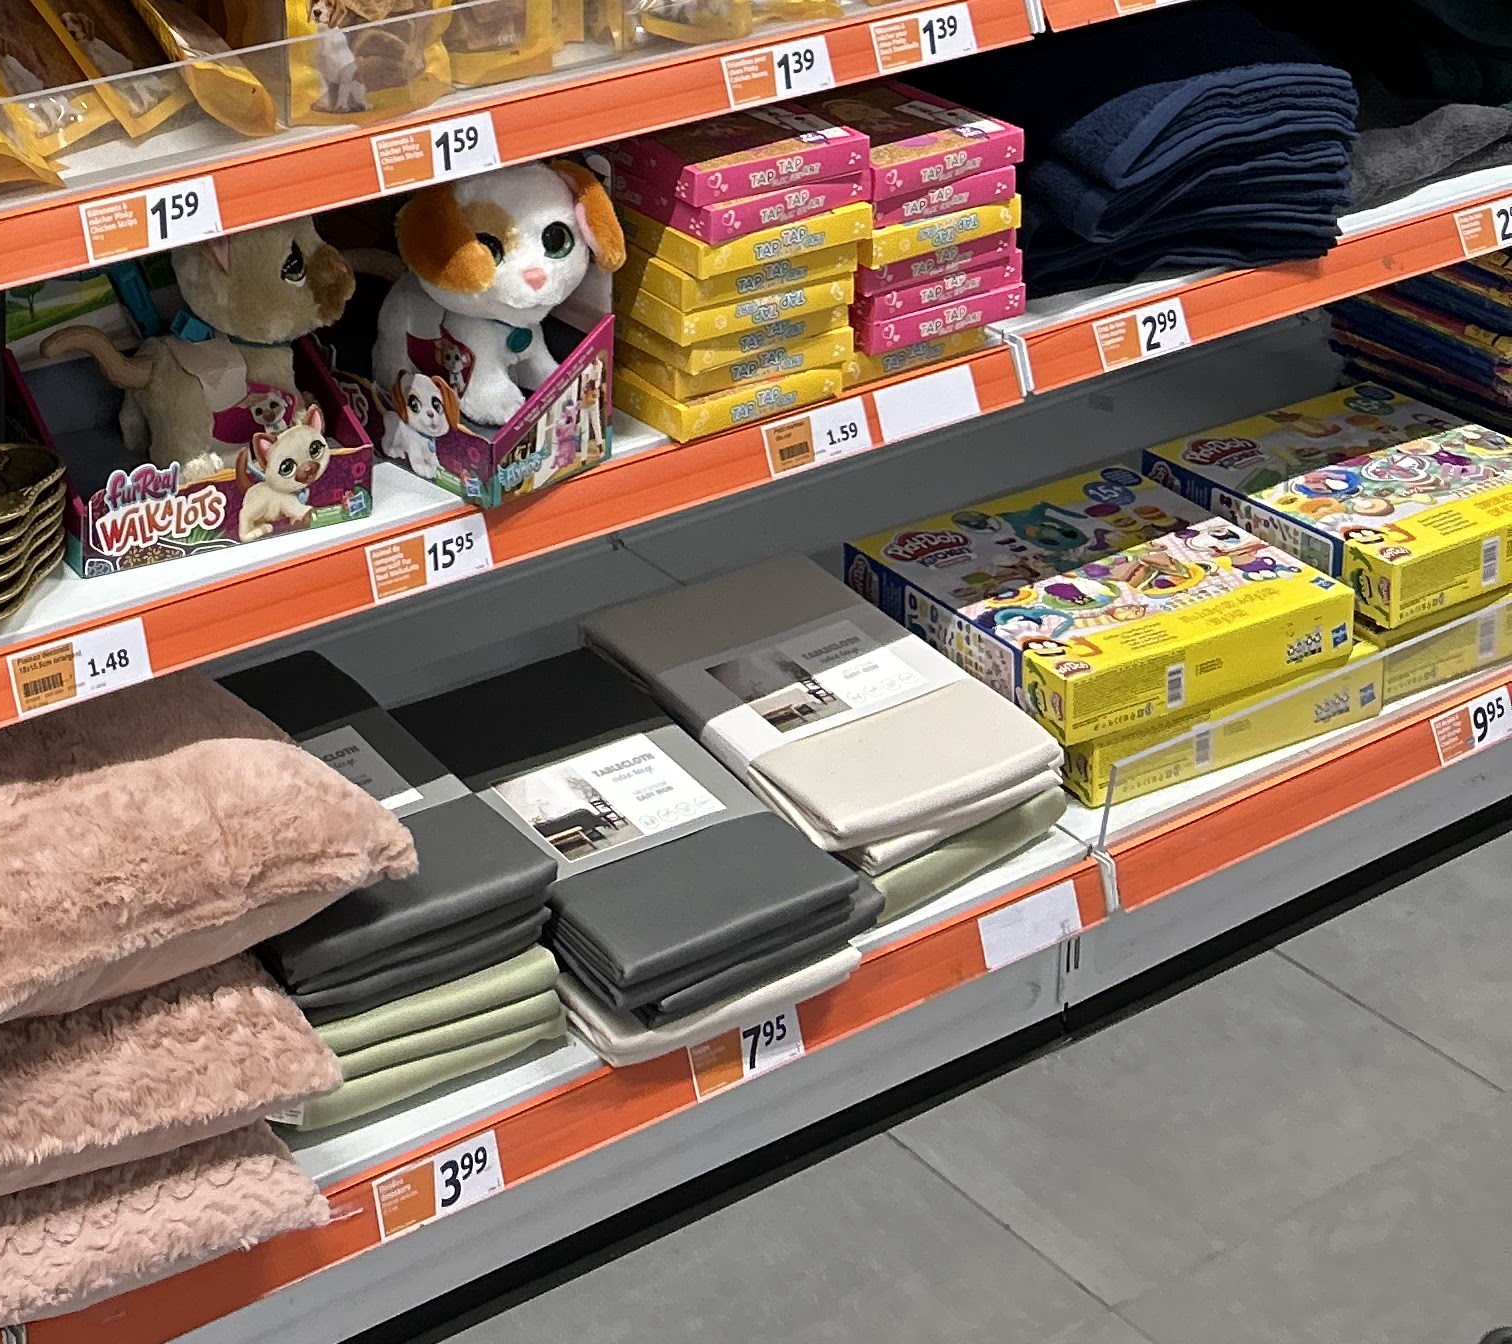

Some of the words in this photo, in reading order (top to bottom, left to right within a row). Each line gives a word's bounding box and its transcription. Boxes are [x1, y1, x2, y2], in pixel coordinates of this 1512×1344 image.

[749, 168, 775, 188] TAP
[776, 155, 804, 175] TAP
[920, 164, 944, 182] TAP
[944, 151, 968, 170] TAP
[760, 204, 784, 223] TAP
[784, 189, 809, 210] TAP
[902, 198, 926, 216] TAP
[928, 185, 954, 204] TAP
[753, 238, 780, 260] TAP
[781, 225, 808, 246] TAP
[919, 319, 943, 337] TAP
[944, 304, 967, 324] TAP
[729, 402, 757, 422] TAP
[756, 385, 782, 406] TAP
[826, 422, 859, 446] 1.59
[98, 490, 225, 552] WALKALOTS
[87, 648, 130, 677] 1.48
[591, 753, 656, 778] TABLECLOTH
